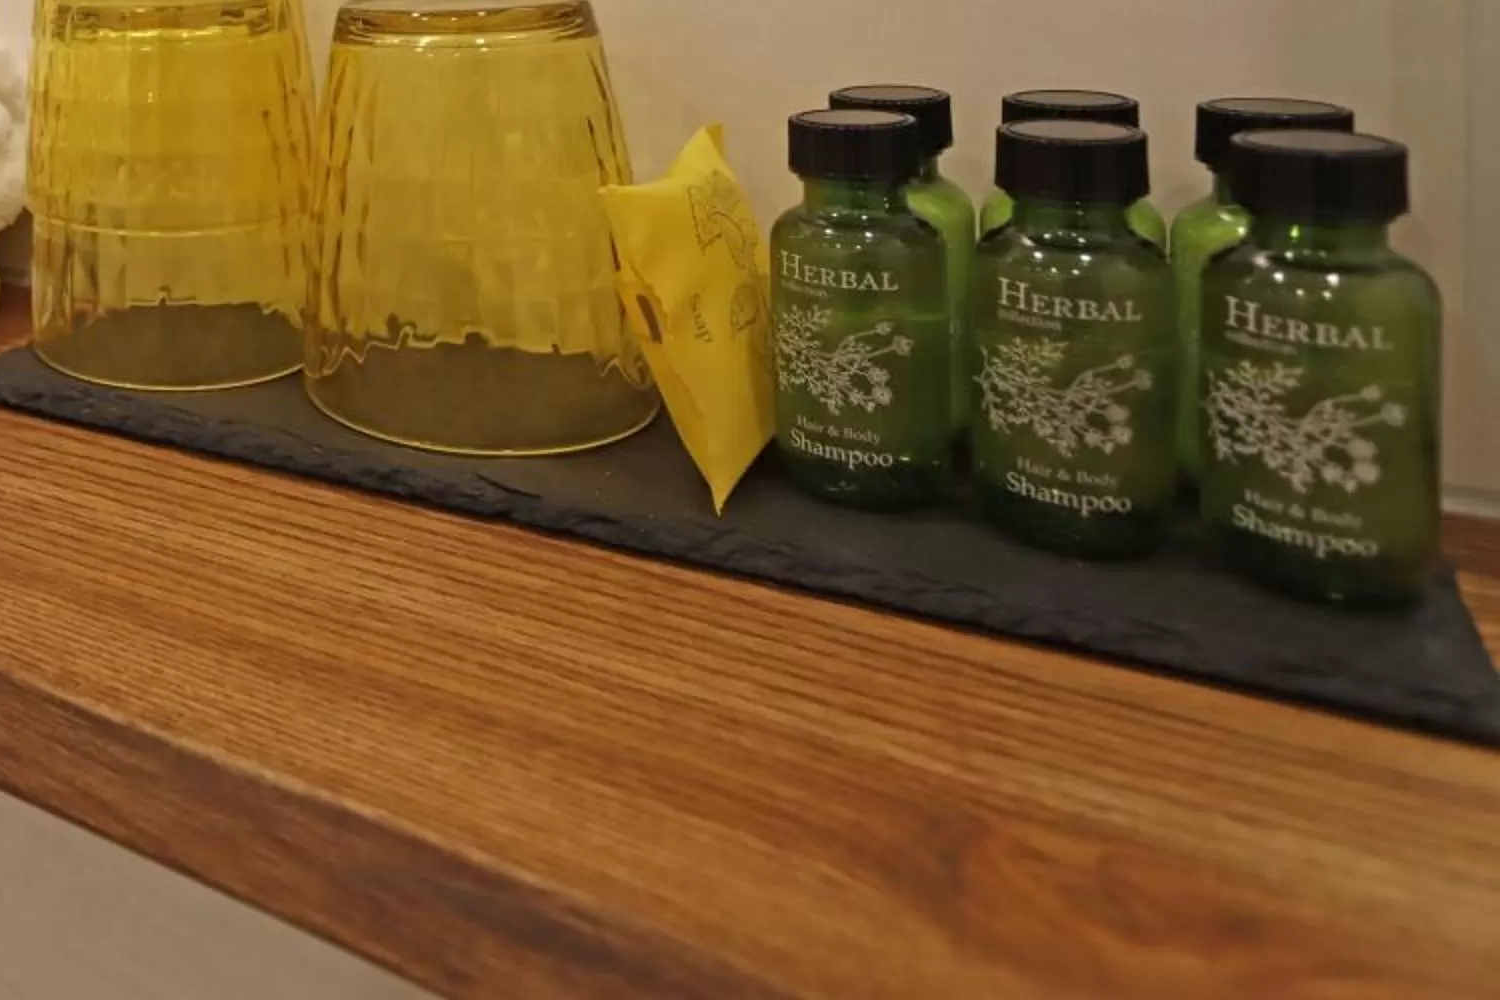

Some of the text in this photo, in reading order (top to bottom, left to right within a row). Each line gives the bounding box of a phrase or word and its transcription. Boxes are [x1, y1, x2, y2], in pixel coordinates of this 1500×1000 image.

[780, 249, 899, 291] HERBAL
[998, 276, 1142, 321] HERBAL
[1224, 295, 1395, 350] HERBAL
[790, 428, 893, 470] Shampoo
[797, 414, 880, 446] Hair & Body
[1006, 471, 1132, 517] Shampoo
[1056, 465, 1071, 482] &
[1232, 503, 1380, 560] Shampoo
